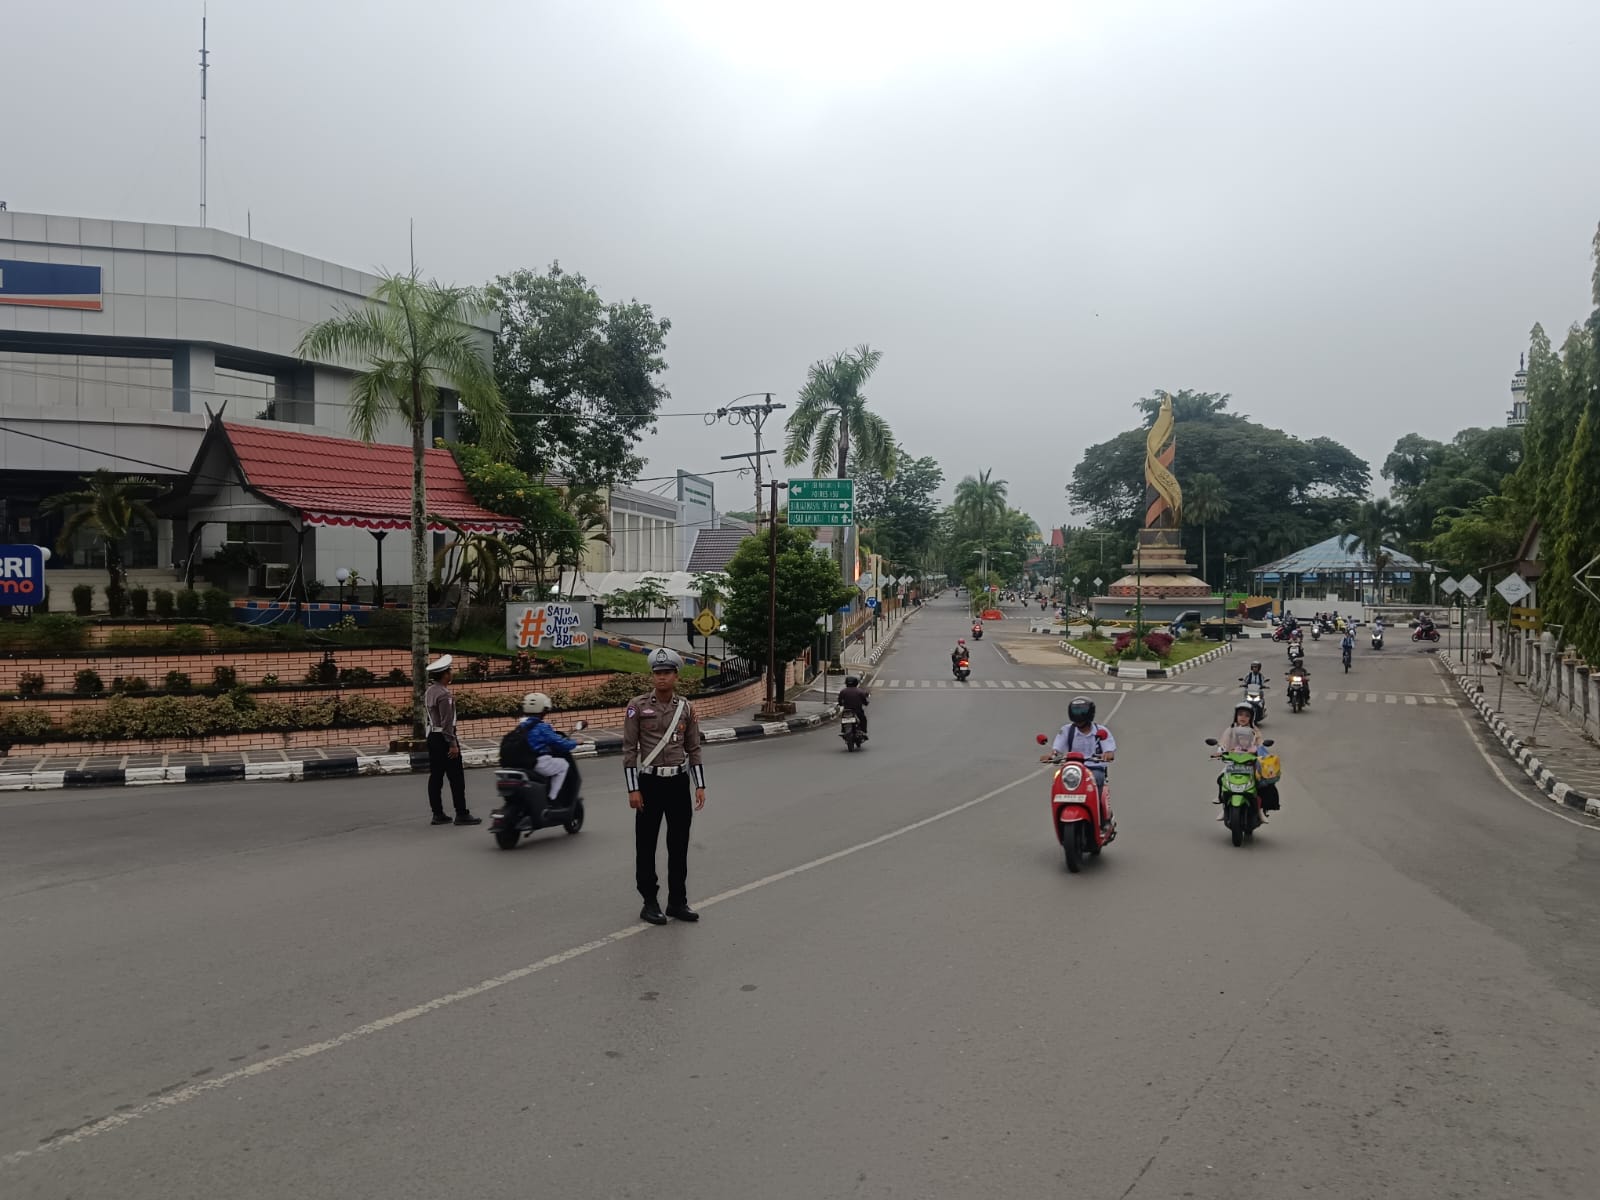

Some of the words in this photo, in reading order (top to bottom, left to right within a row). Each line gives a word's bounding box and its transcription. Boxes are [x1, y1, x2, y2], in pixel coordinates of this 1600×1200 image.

[0, 557, 32, 578] RI
[547, 605, 571, 618] SATU
[554, 615, 579, 626] NUSA
[546, 624, 569, 636] SATU
[555, 634, 586, 647] BRIMO
